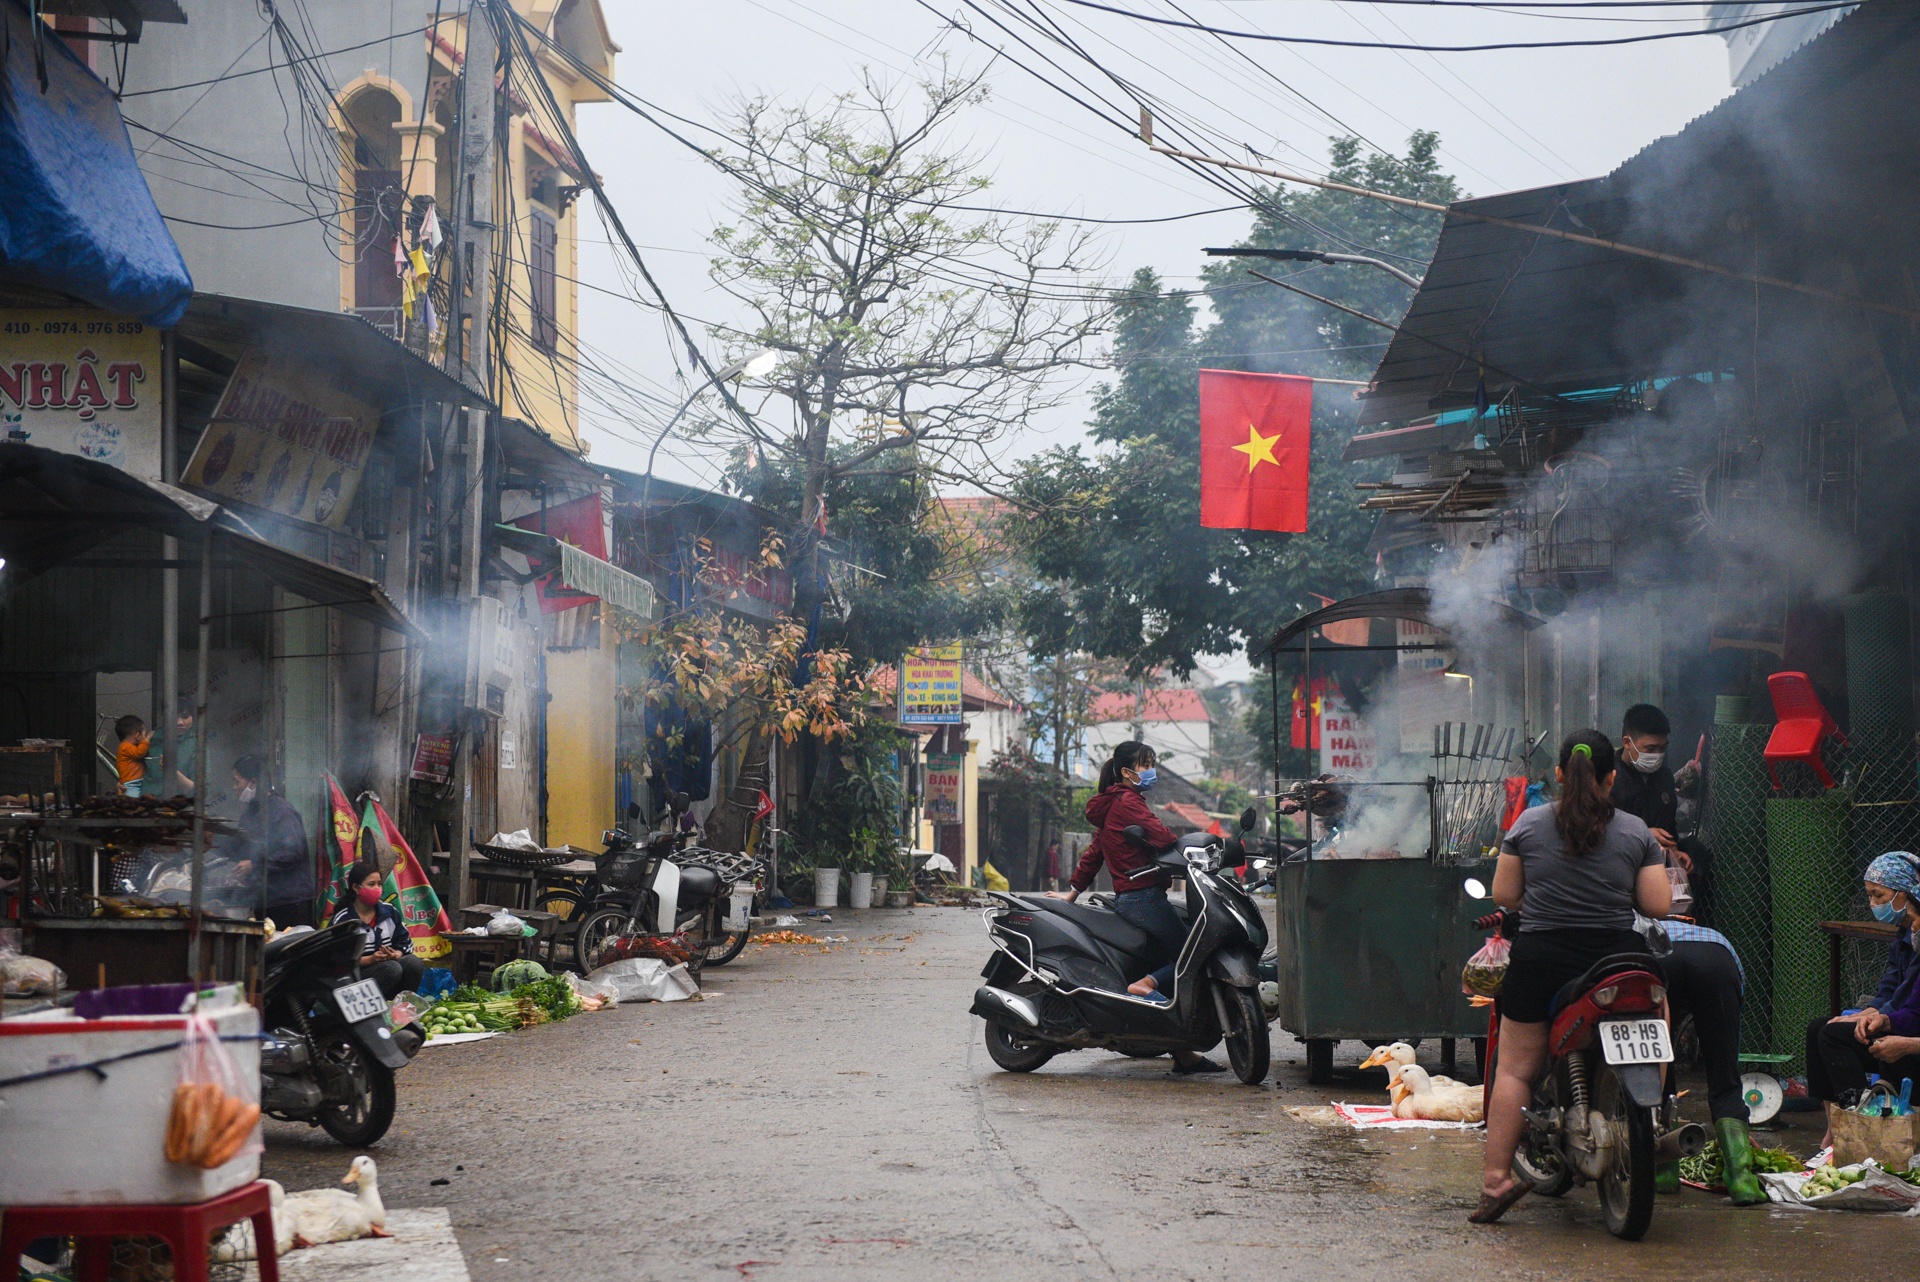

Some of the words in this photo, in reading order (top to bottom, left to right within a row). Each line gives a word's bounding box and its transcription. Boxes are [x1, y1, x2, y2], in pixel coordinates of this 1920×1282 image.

[5, 322, 30, 334] 410
[87, 322, 113, 334] 976
[117, 322, 143, 334] 859
[1610, 1023, 1659, 1041] 88-H9
[1615, 1041, 1663, 1060] 1106
